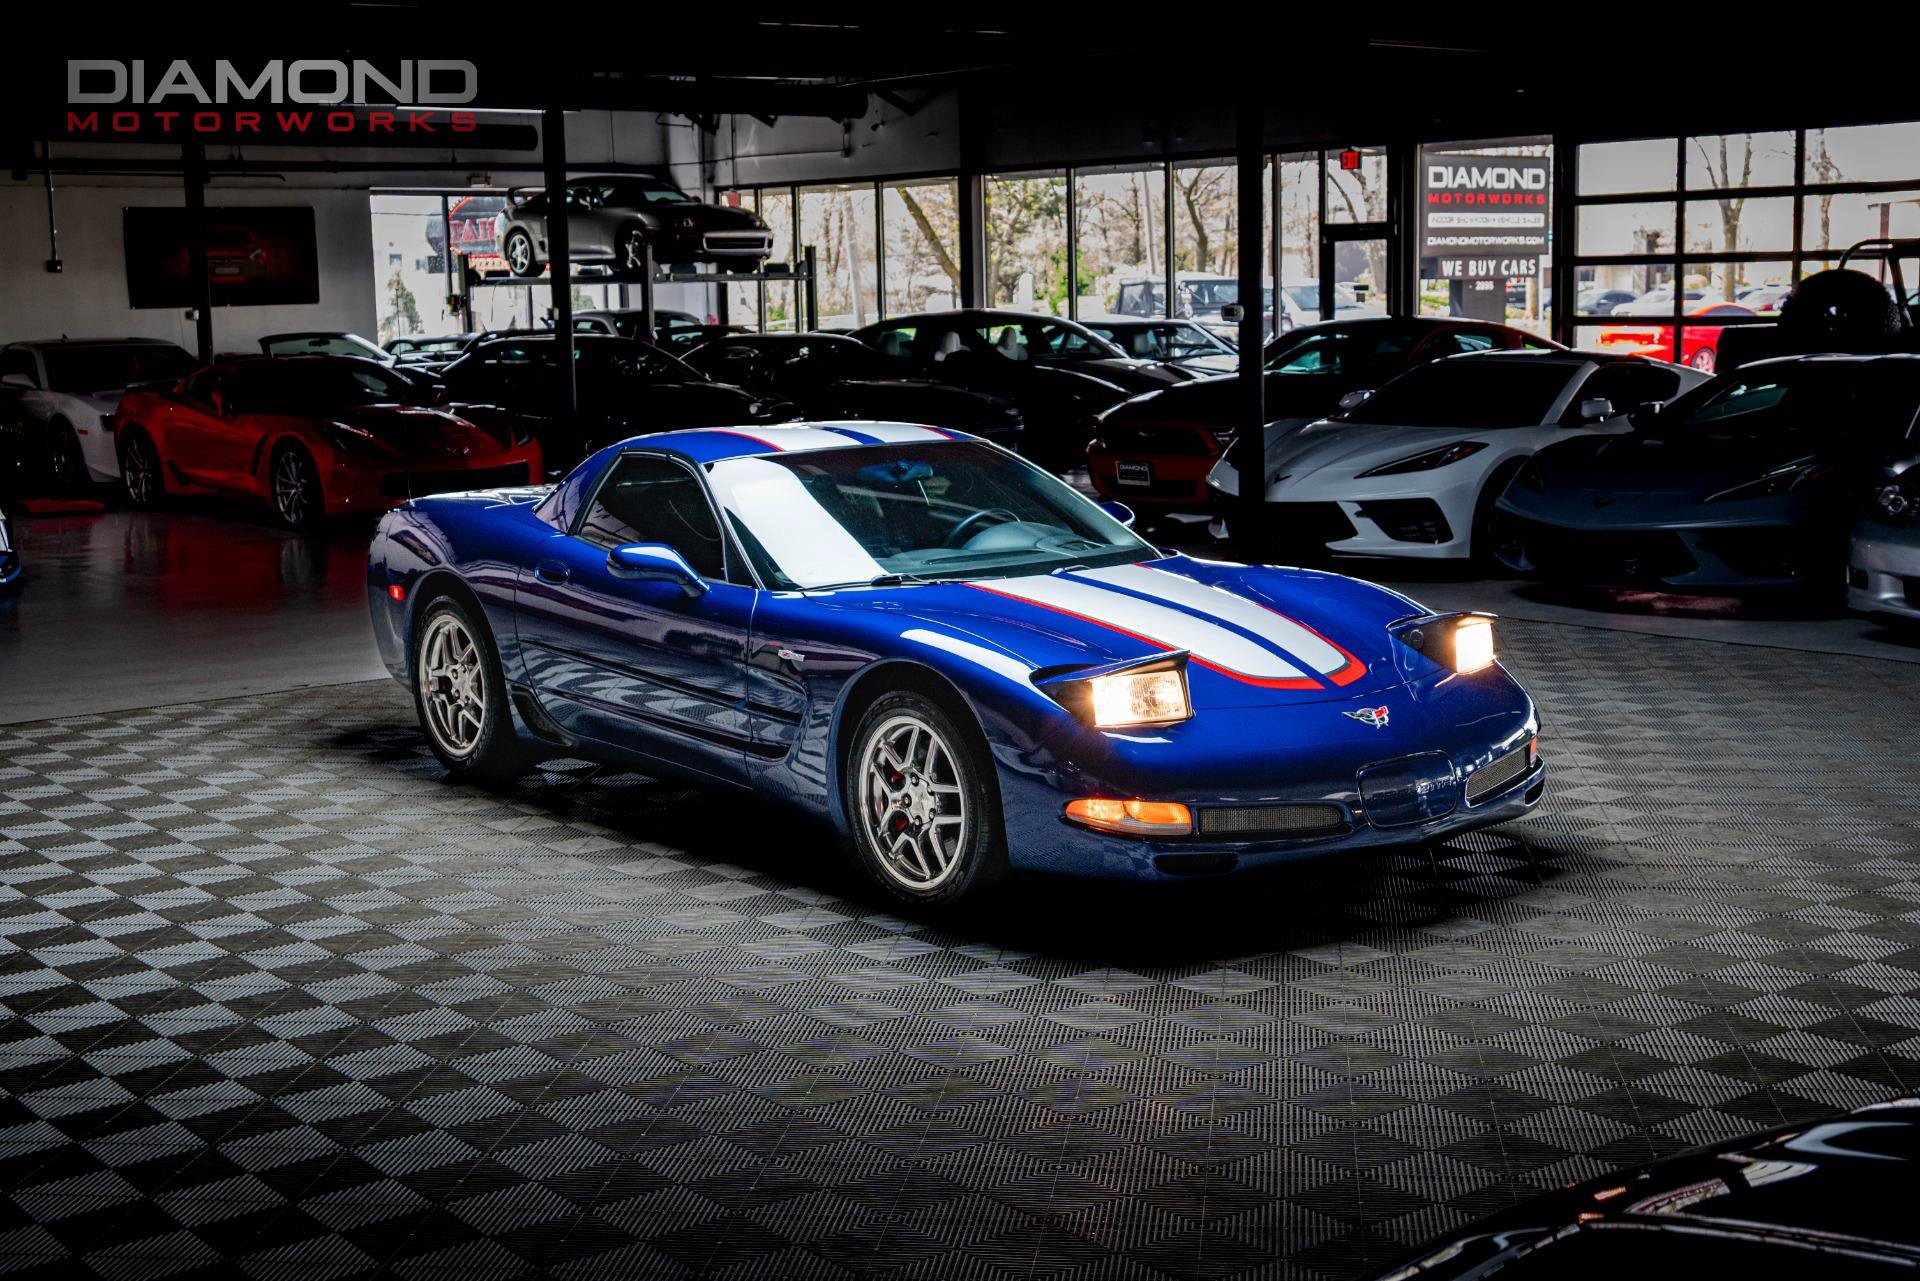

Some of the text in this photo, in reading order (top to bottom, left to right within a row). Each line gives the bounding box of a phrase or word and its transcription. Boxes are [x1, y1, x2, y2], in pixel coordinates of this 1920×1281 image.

[1427, 166, 1546, 189] DIAMOND
[1427, 193, 1546, 205] MOTORWORKS
[1442, 259, 1536, 276] WE BUY CARS
